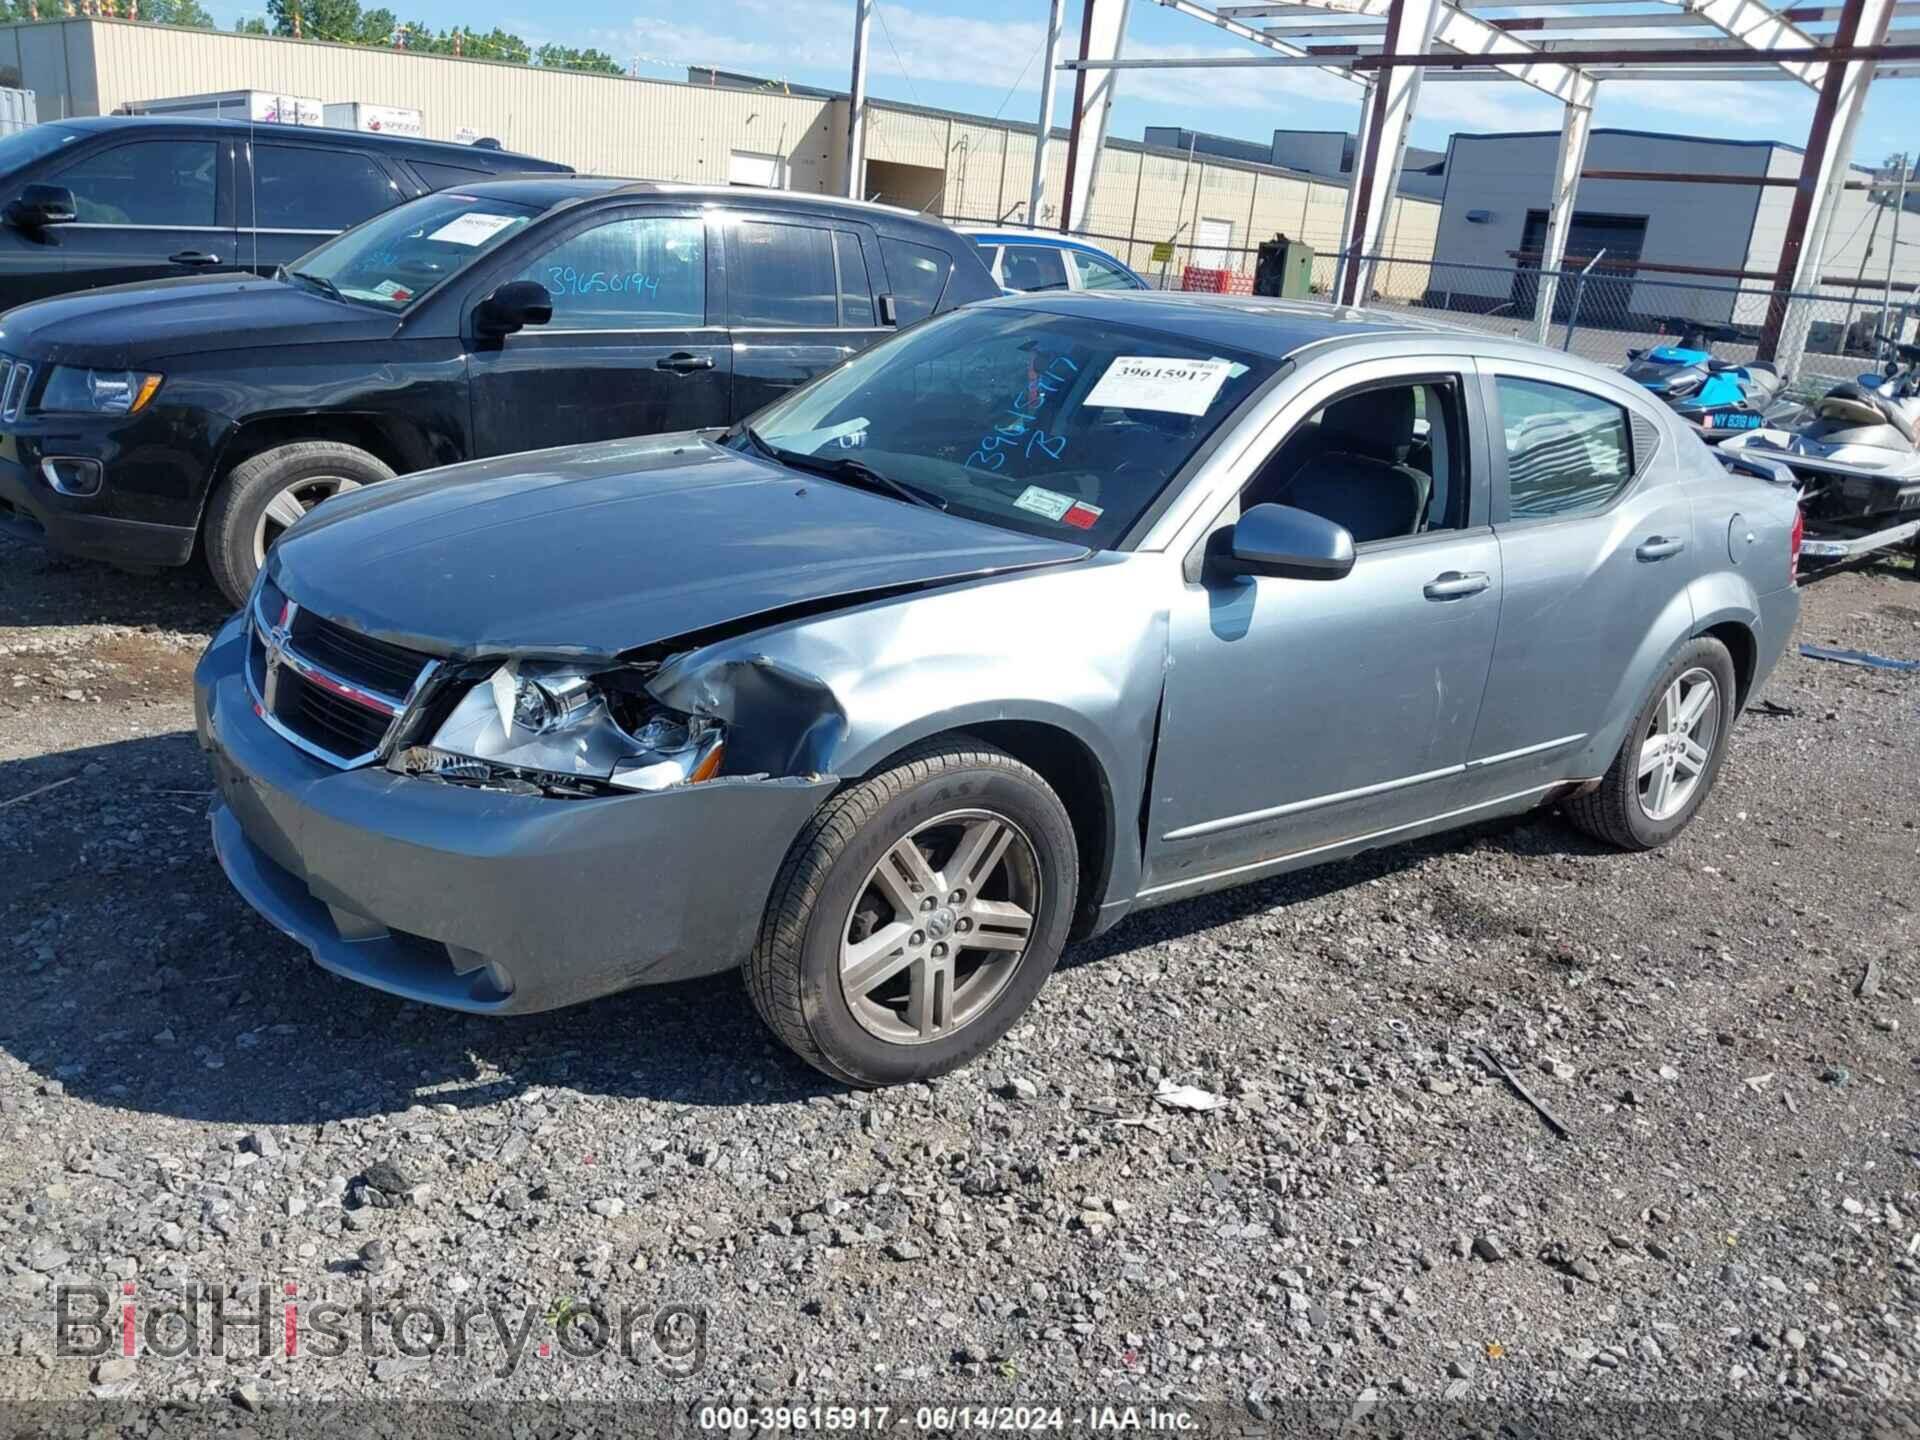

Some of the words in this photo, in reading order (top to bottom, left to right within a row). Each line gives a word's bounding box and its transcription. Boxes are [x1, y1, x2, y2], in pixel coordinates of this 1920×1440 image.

[1116, 366, 1213, 382] 39615917
[1713, 413, 1728, 426] NY
[1025, 430, 1066, 460] B
